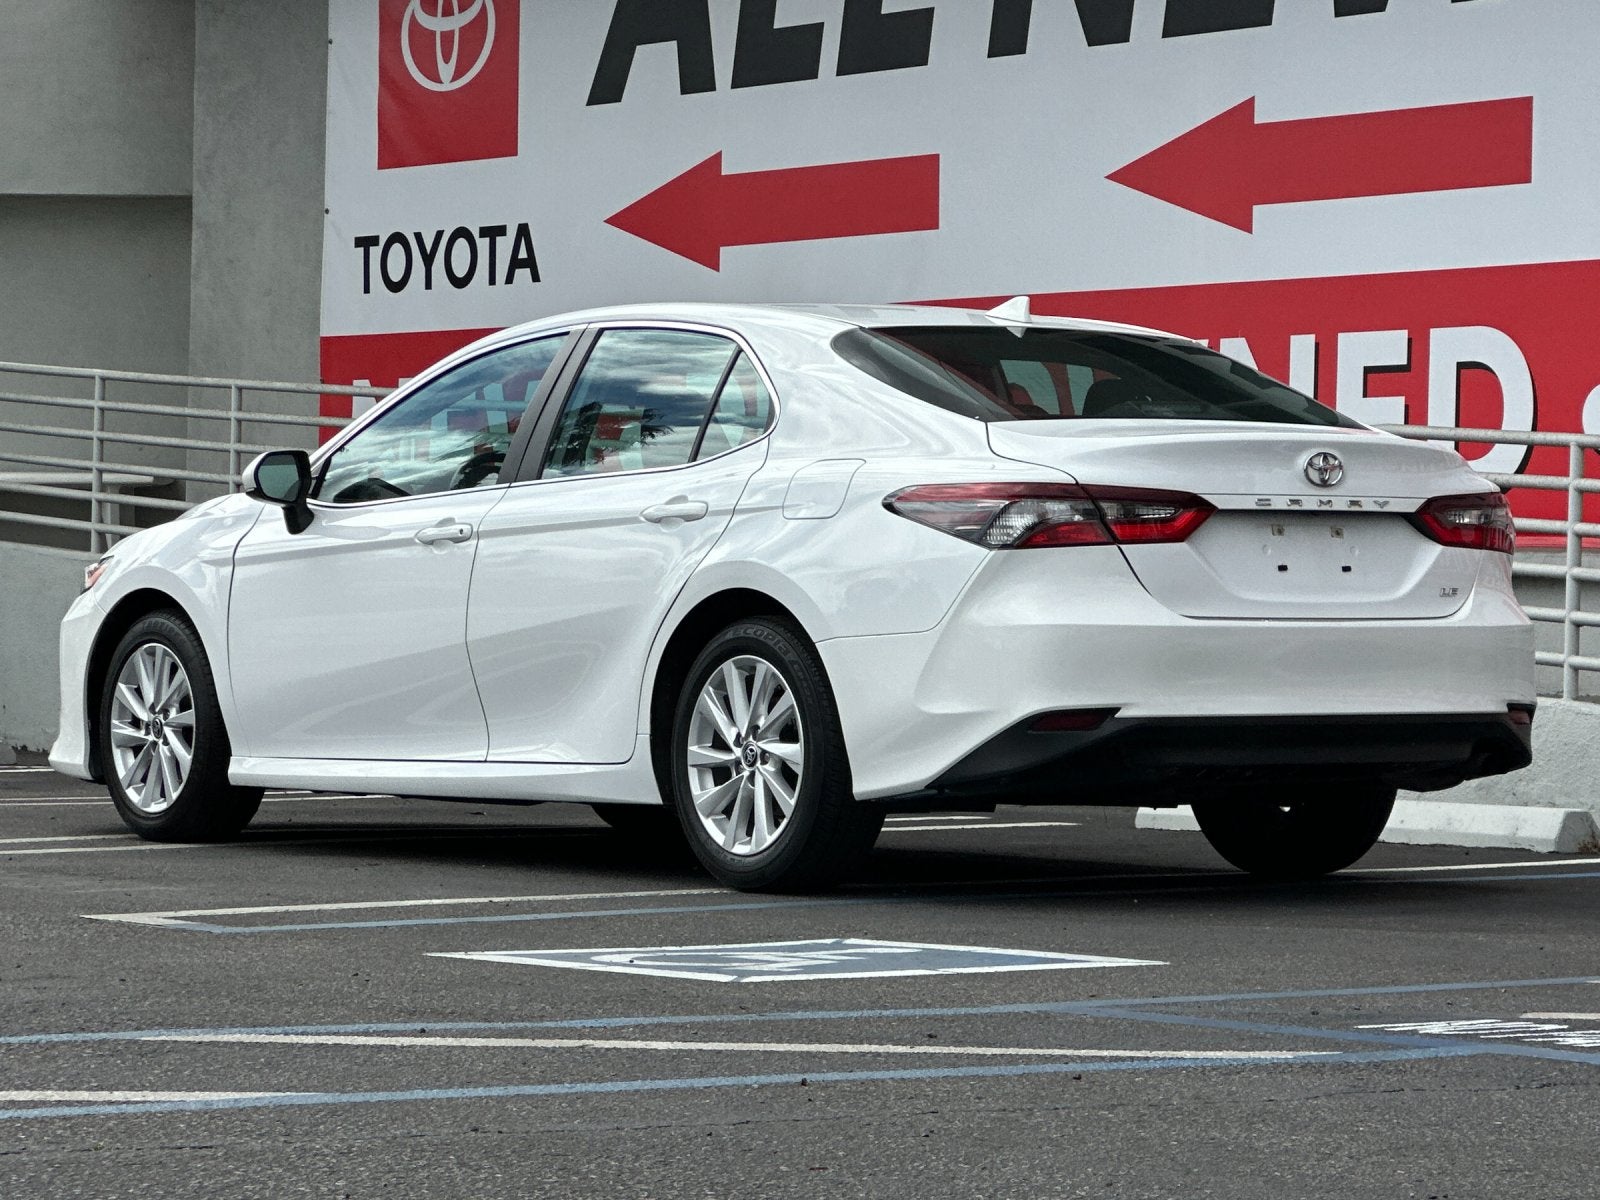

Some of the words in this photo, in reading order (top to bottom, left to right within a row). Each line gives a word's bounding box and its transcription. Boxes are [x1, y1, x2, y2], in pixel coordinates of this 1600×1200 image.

[354, 222, 542, 294] TOYOTA
[1255, 498, 1390, 509] CAMRY
[1439, 587, 1460, 598] LE
